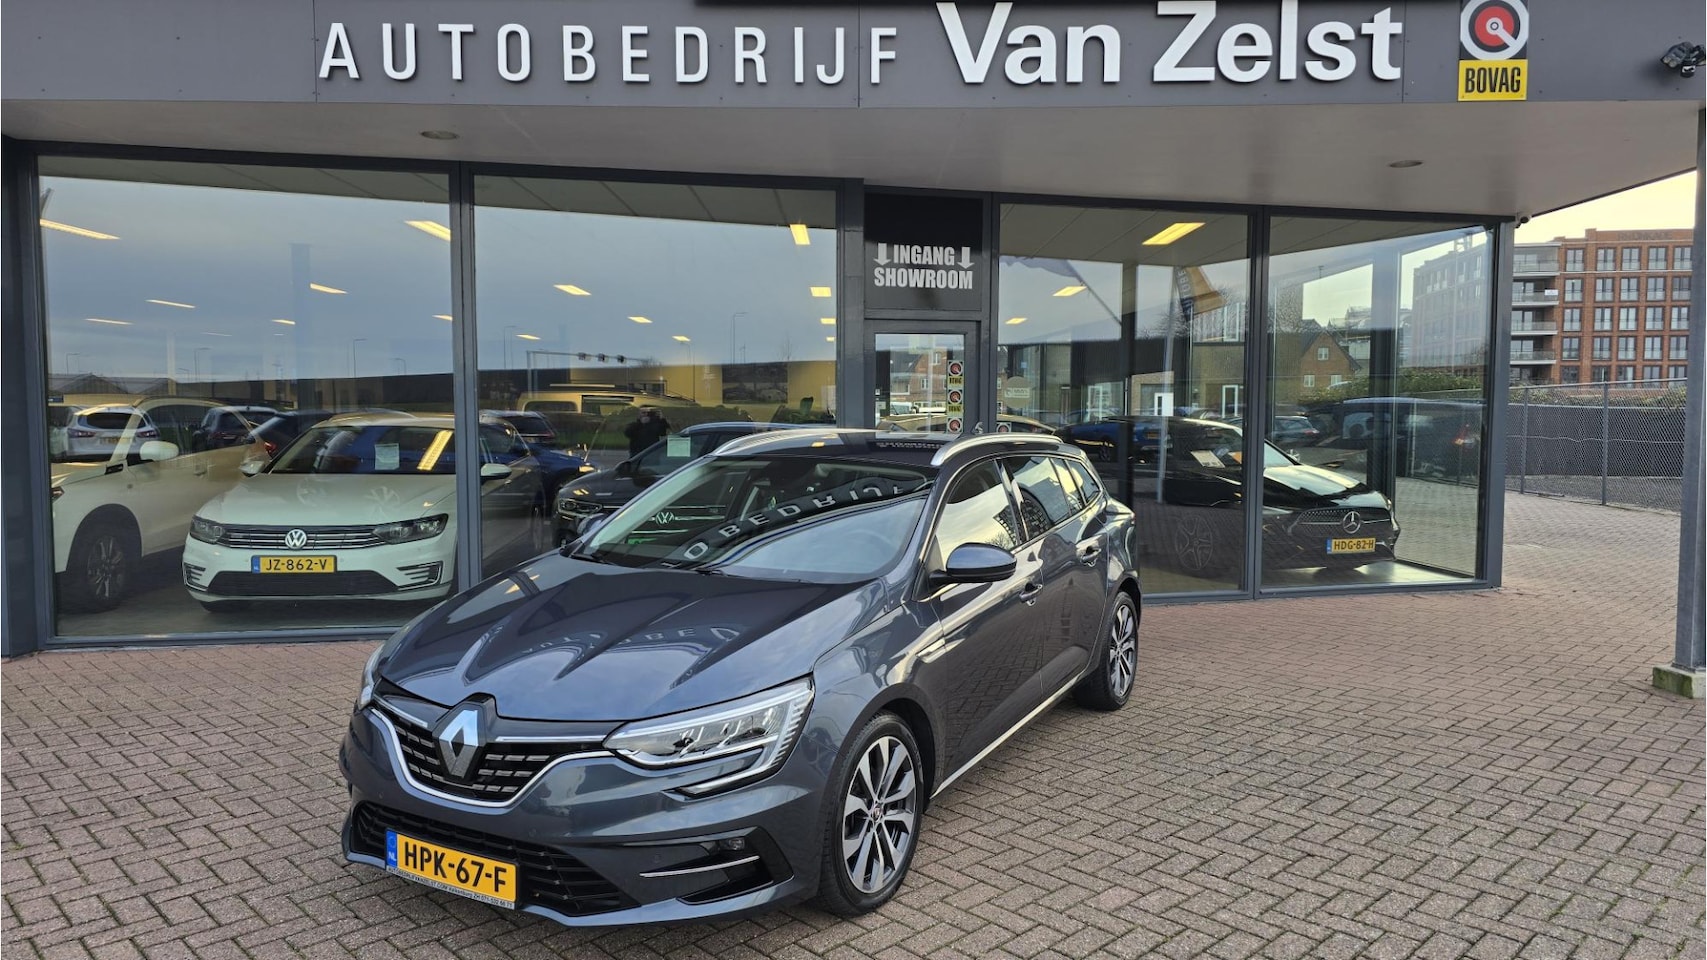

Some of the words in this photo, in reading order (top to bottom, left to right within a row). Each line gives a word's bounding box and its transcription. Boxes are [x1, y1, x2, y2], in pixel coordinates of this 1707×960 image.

[319, 23, 897, 84] AUTOBEDRIJF
[936, 2, 1120, 84] Van
[1153, 0, 1403, 84] Zelst
[1465, 67, 1521, 94] BOVAG
[893, 245, 955, 266] INGANG
[874, 267, 973, 290] SHOWROOM
[1334, 540, 1374, 550] HDG-82-H
[266, 559, 327, 571] JZ-862-V
[388, 851, 397, 861] NL
[404, 841, 507, 893] HPK-67-F
